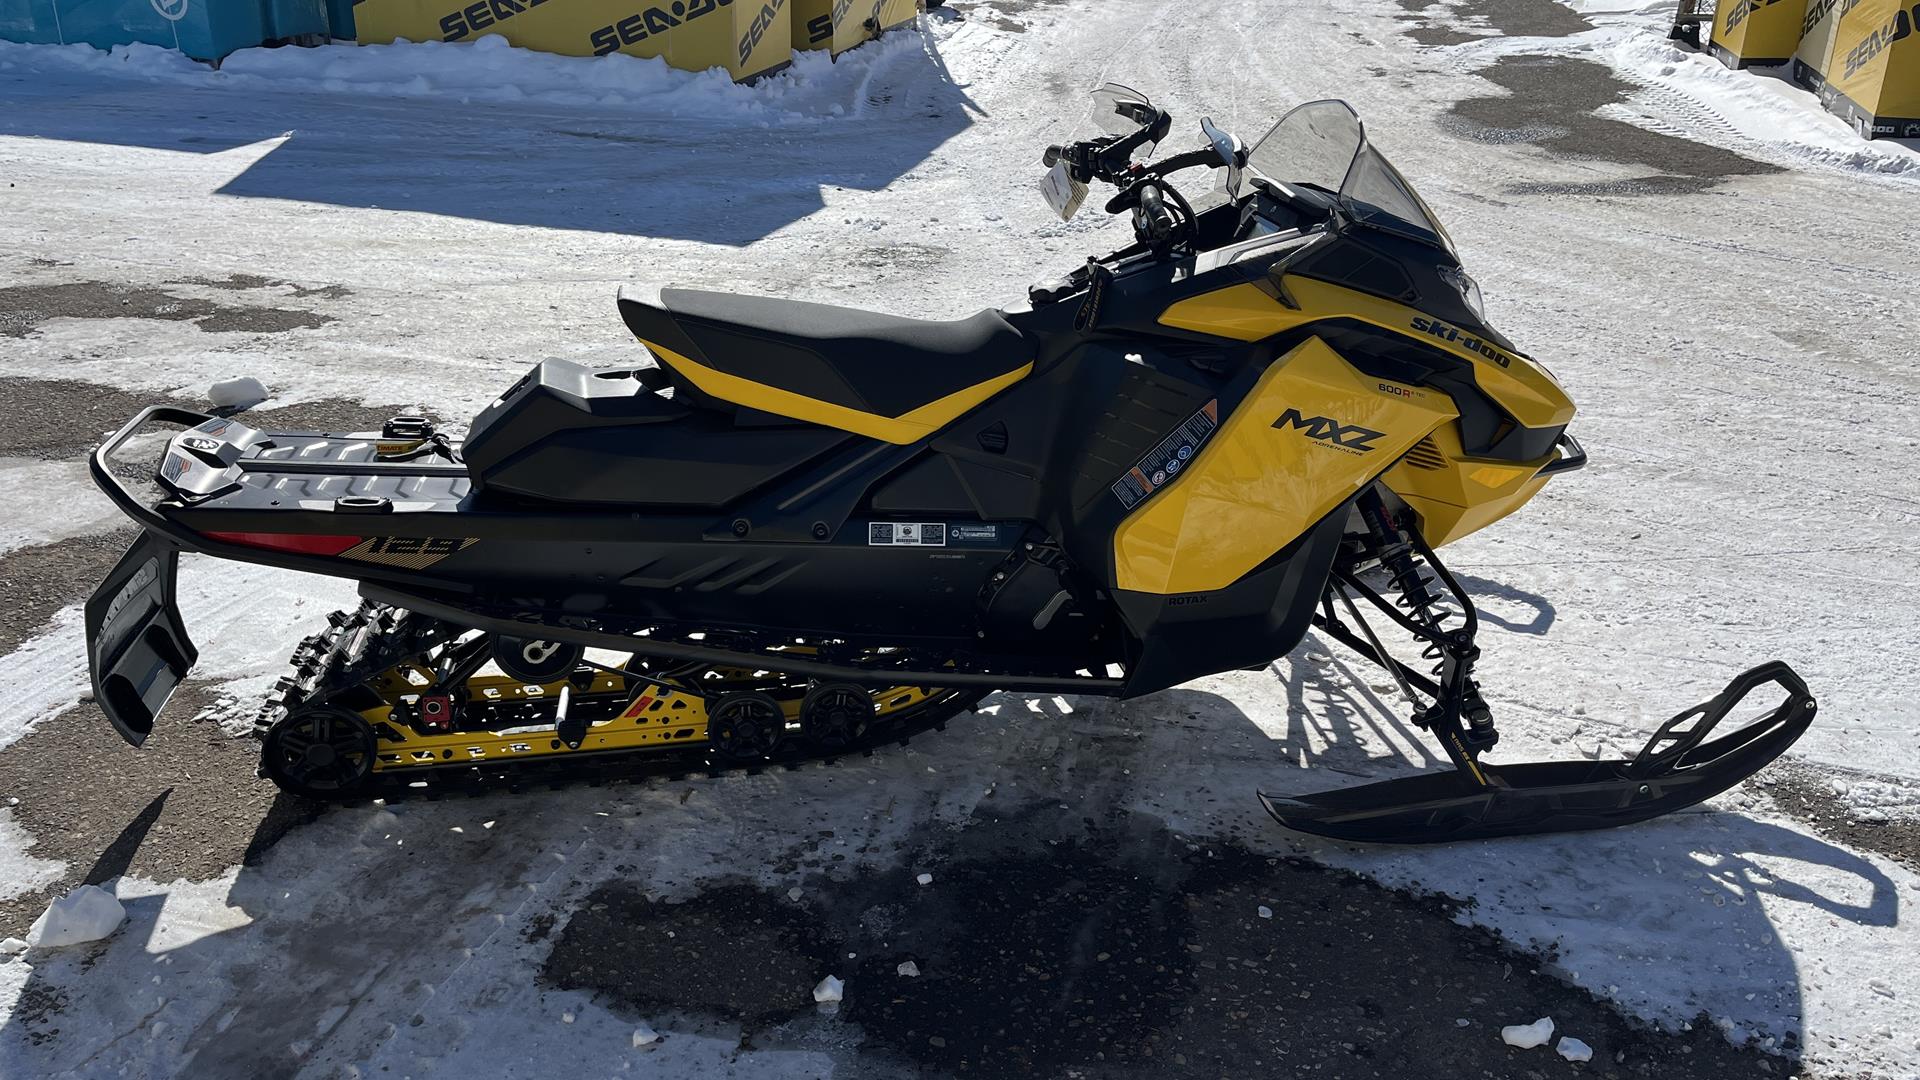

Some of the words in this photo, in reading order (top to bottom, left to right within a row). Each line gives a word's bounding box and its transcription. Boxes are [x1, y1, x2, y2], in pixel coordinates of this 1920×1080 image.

[1271, 407, 1386, 452] MXZ
[1312, 440, 1364, 457] ADRENALINE
[1167, 594, 1208, 606] ROTAX
